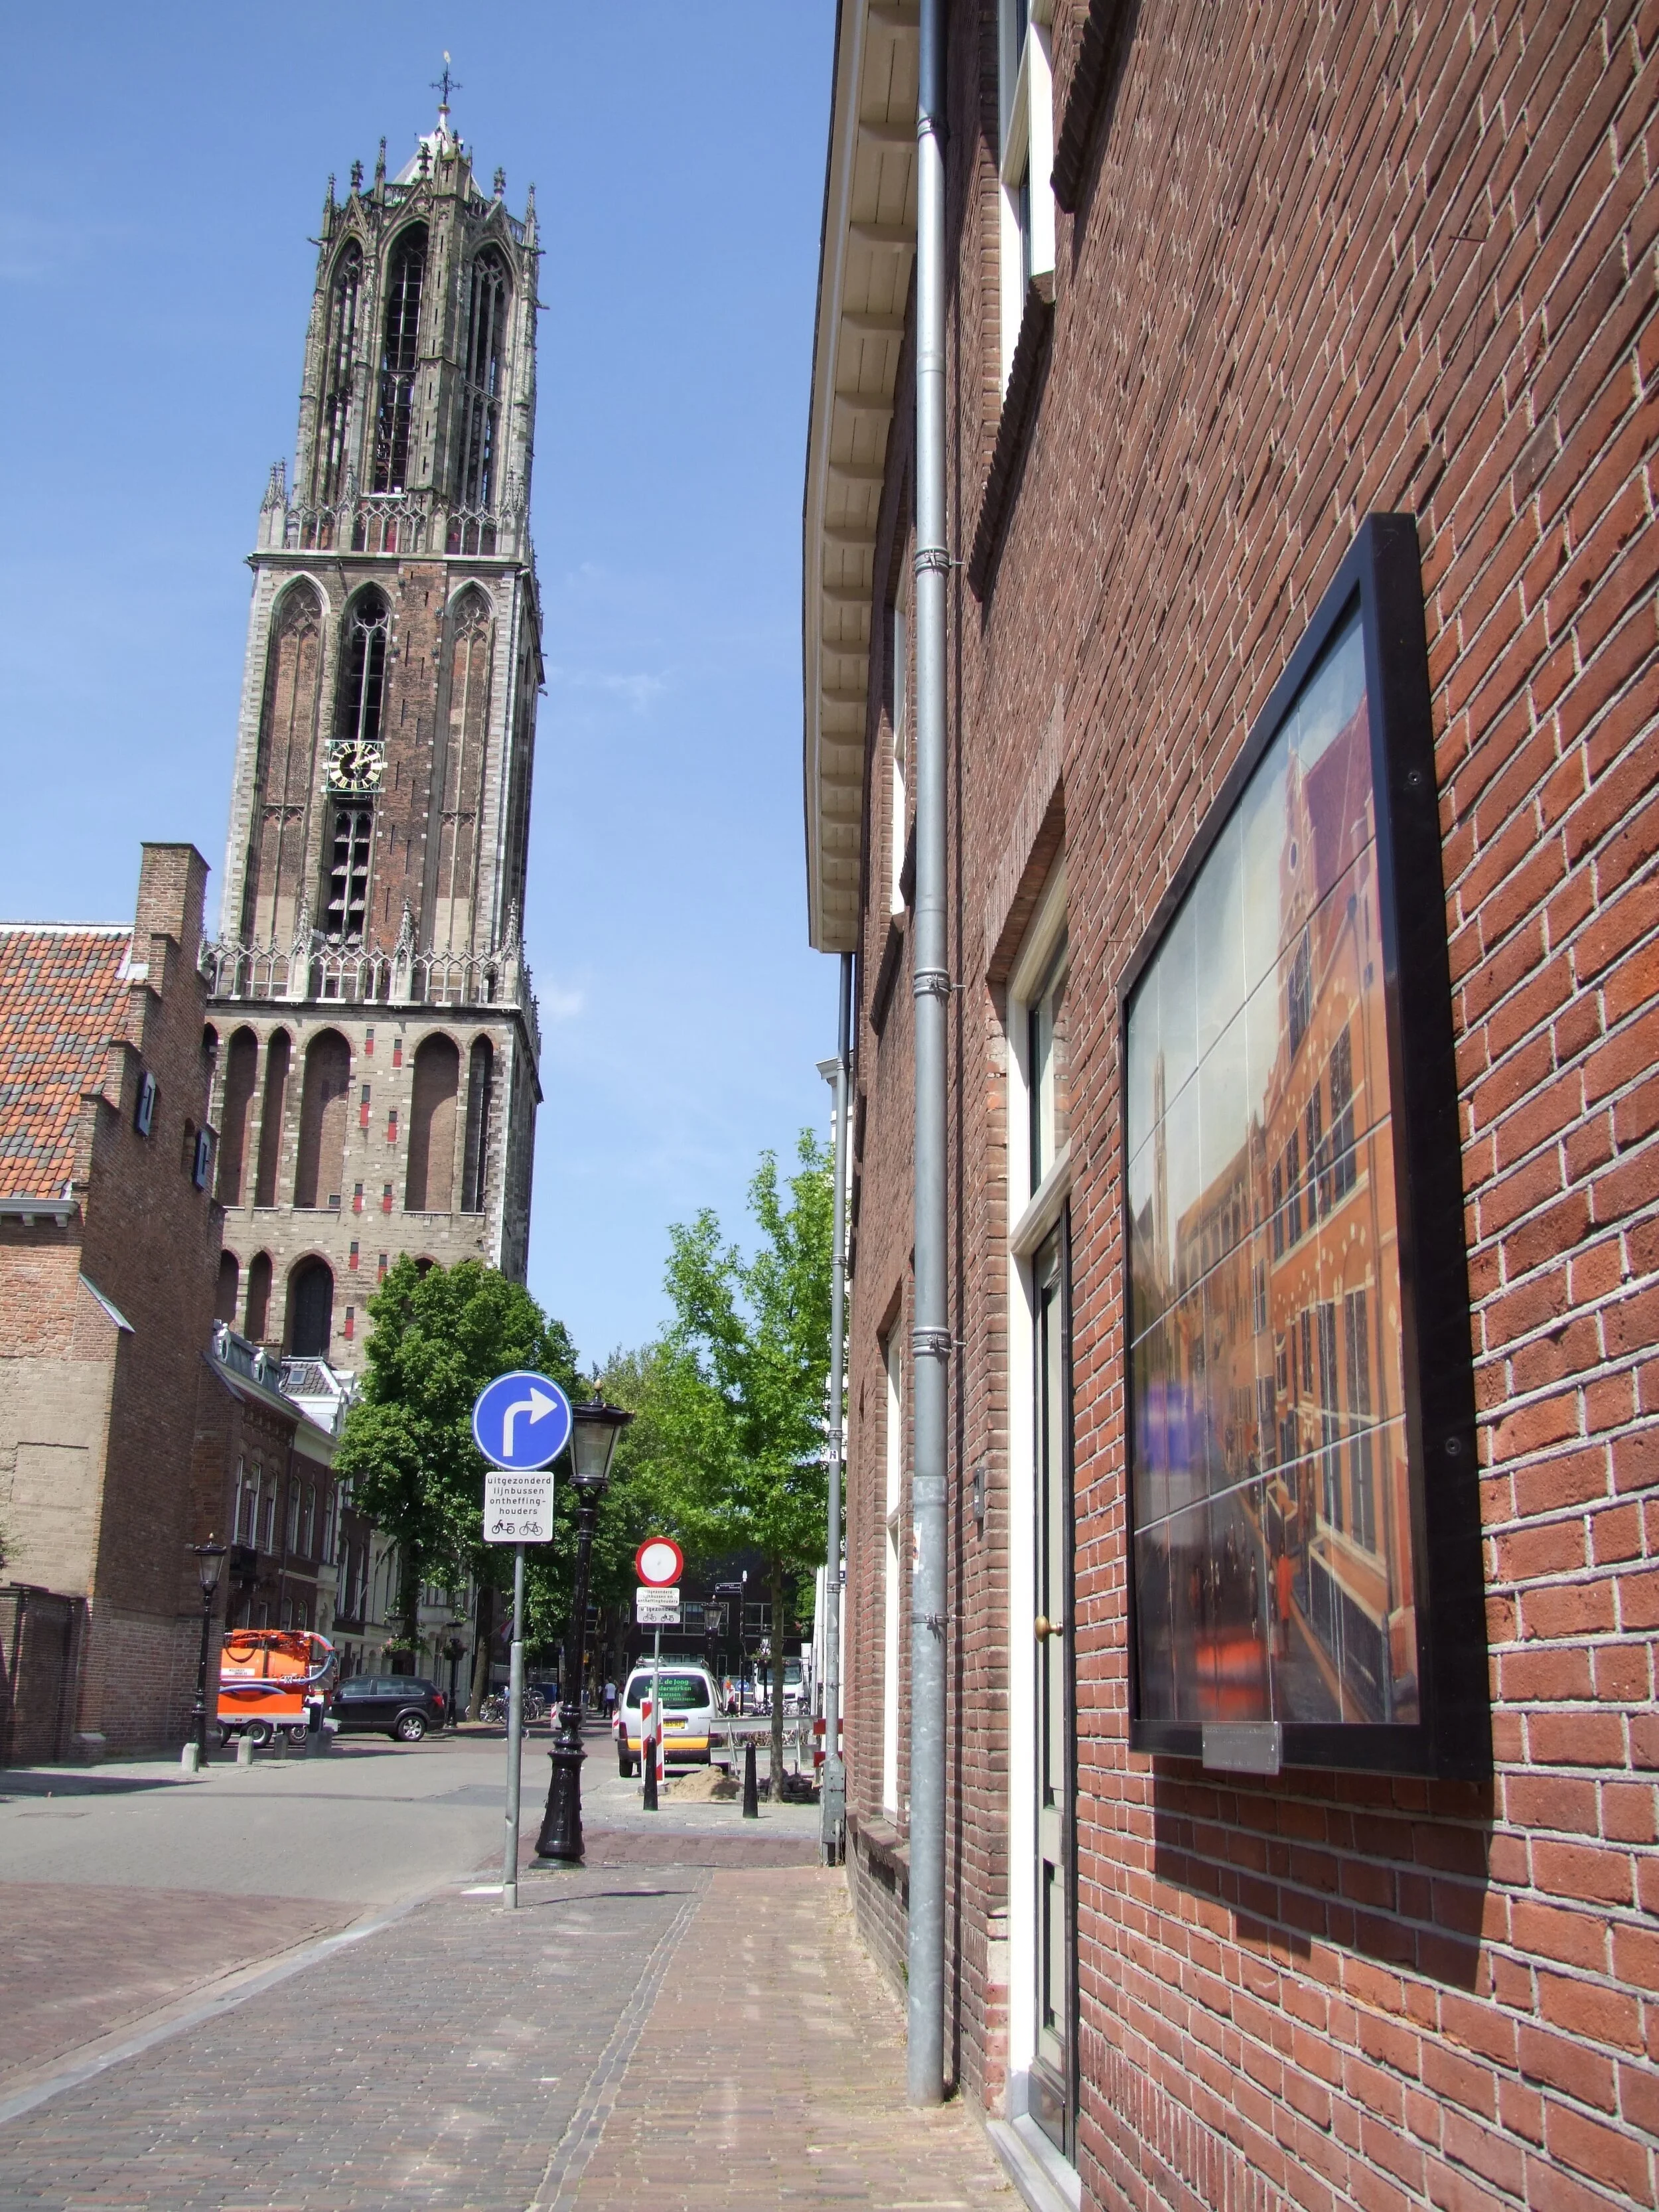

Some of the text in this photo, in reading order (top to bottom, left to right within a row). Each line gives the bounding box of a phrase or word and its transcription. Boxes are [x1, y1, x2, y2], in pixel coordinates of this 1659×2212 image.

[488, 1477, 551, 1486] uitgezonderd
[494, 1487, 544, 1496] lijnbussen
[490, 1497, 546, 1506] ontheffing-
